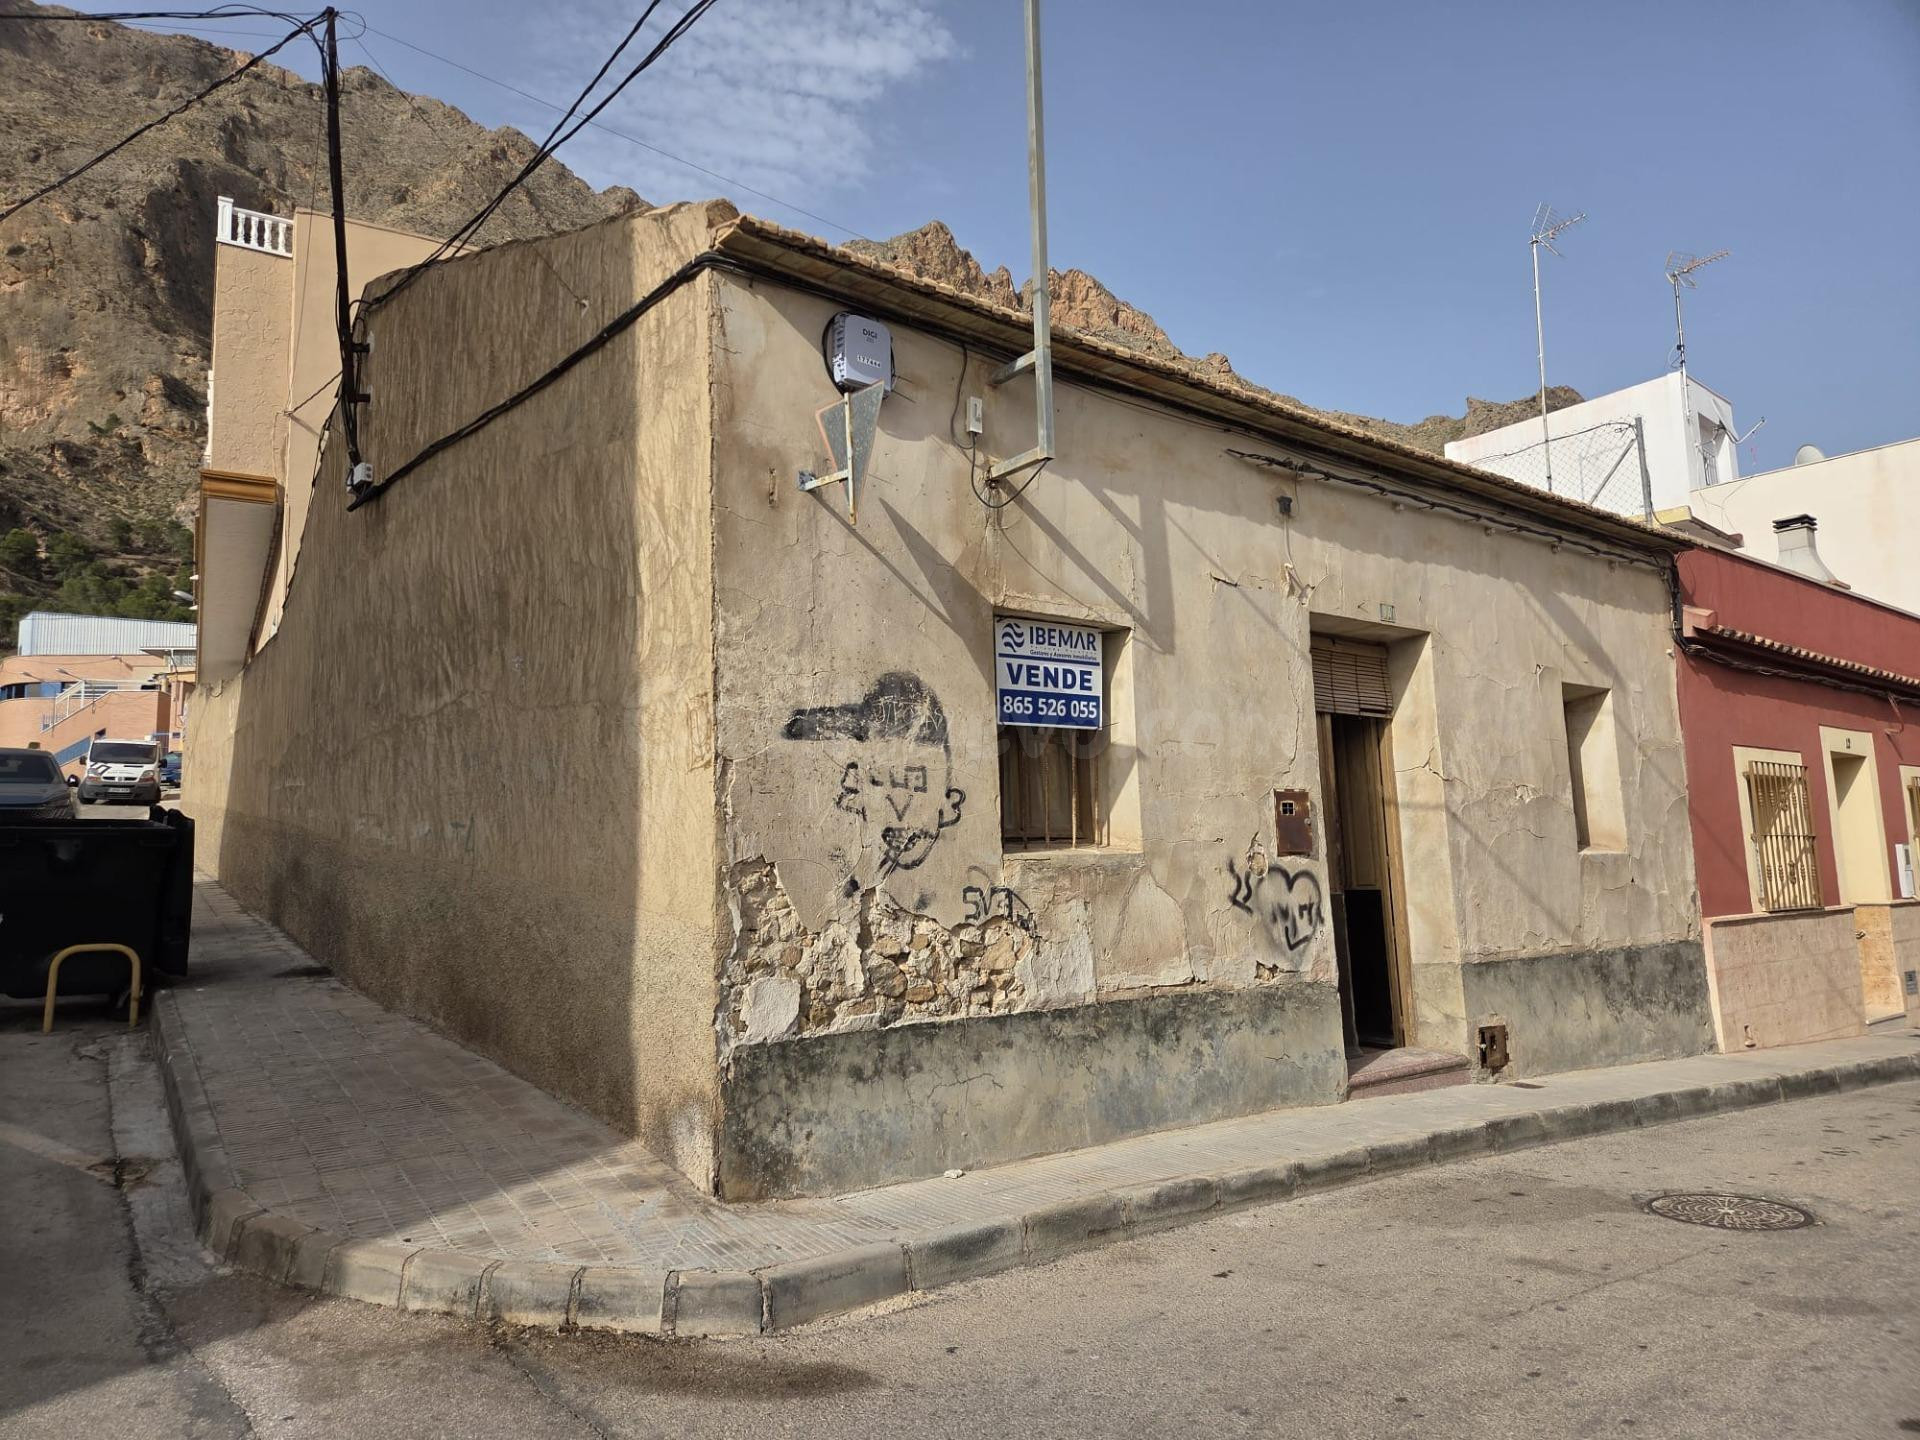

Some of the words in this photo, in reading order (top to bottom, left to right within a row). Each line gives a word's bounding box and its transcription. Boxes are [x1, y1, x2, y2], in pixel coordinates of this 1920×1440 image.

[1029, 626, 1097, 651] IBEMAR
[1006, 662, 1093, 691] VENDE
[1003, 695, 1033, 714] 865
[1038, 698, 1066, 717] 526
[1070, 700, 1097, 719] 055
